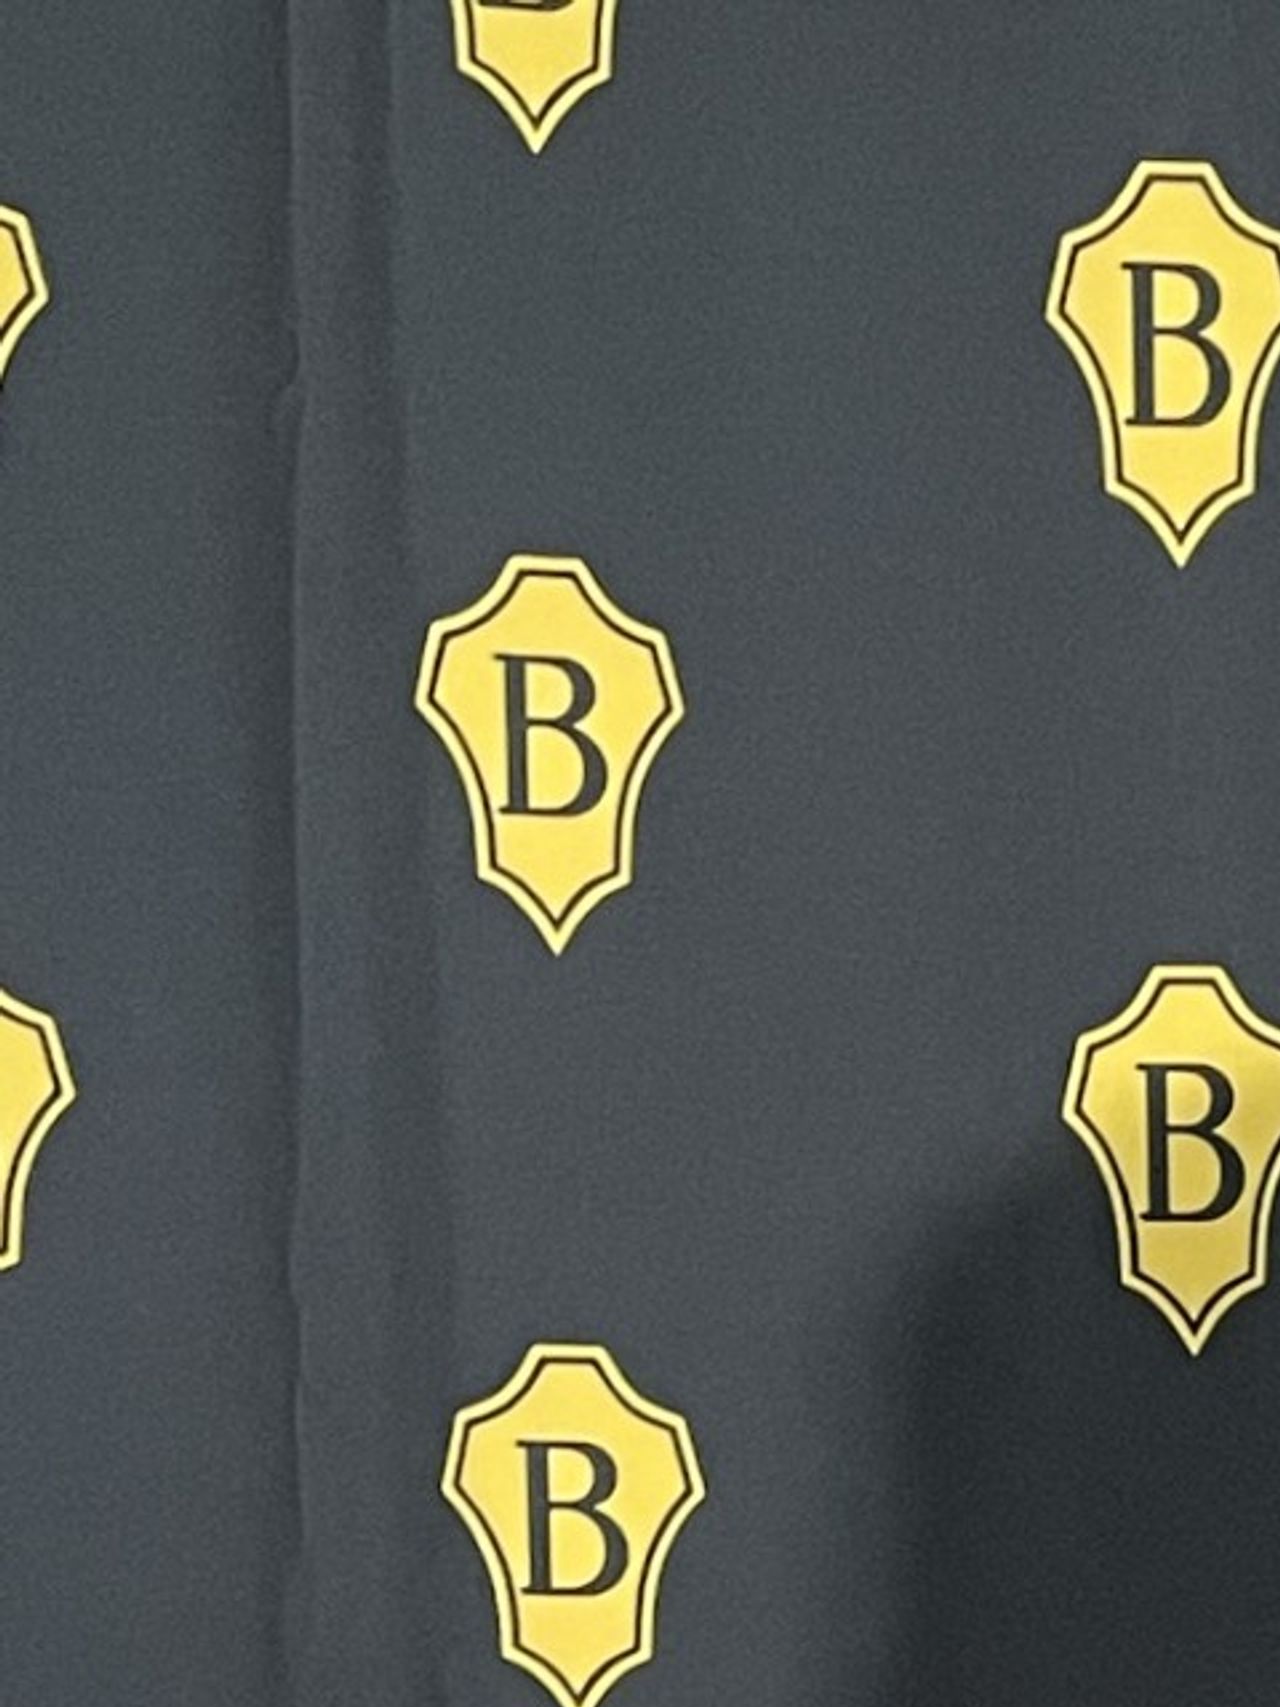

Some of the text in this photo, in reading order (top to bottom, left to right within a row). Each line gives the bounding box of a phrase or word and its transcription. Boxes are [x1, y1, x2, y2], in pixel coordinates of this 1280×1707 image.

[1122, 263, 1230, 426] B
[496, 655, 607, 815] B
[1137, 1064, 1245, 1222] B
[518, 1441, 627, 1595] B
